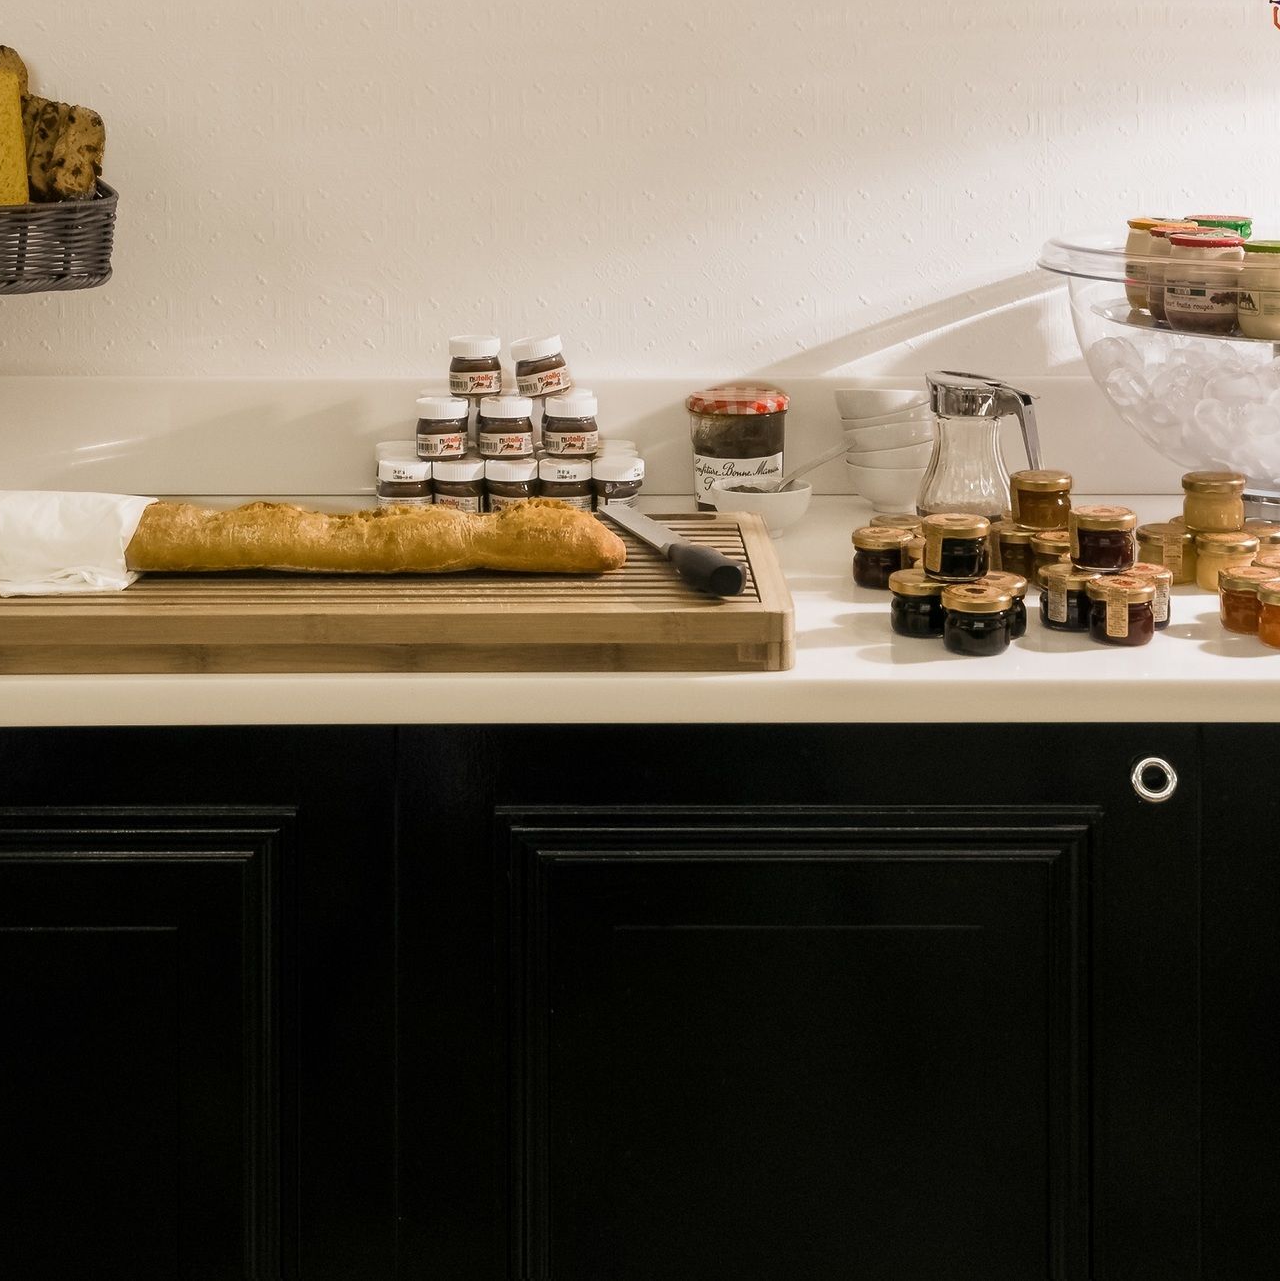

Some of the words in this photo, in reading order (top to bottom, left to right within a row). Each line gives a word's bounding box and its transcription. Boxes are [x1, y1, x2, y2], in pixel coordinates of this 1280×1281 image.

[469, 374, 494, 383] nutella
[537, 371, 561, 384] nutella
[439, 435, 463, 445] nutella
[499, 436, 524, 445] nutella
[560, 436, 586, 445] nutella
[722, 461, 753, 477] Bonne
